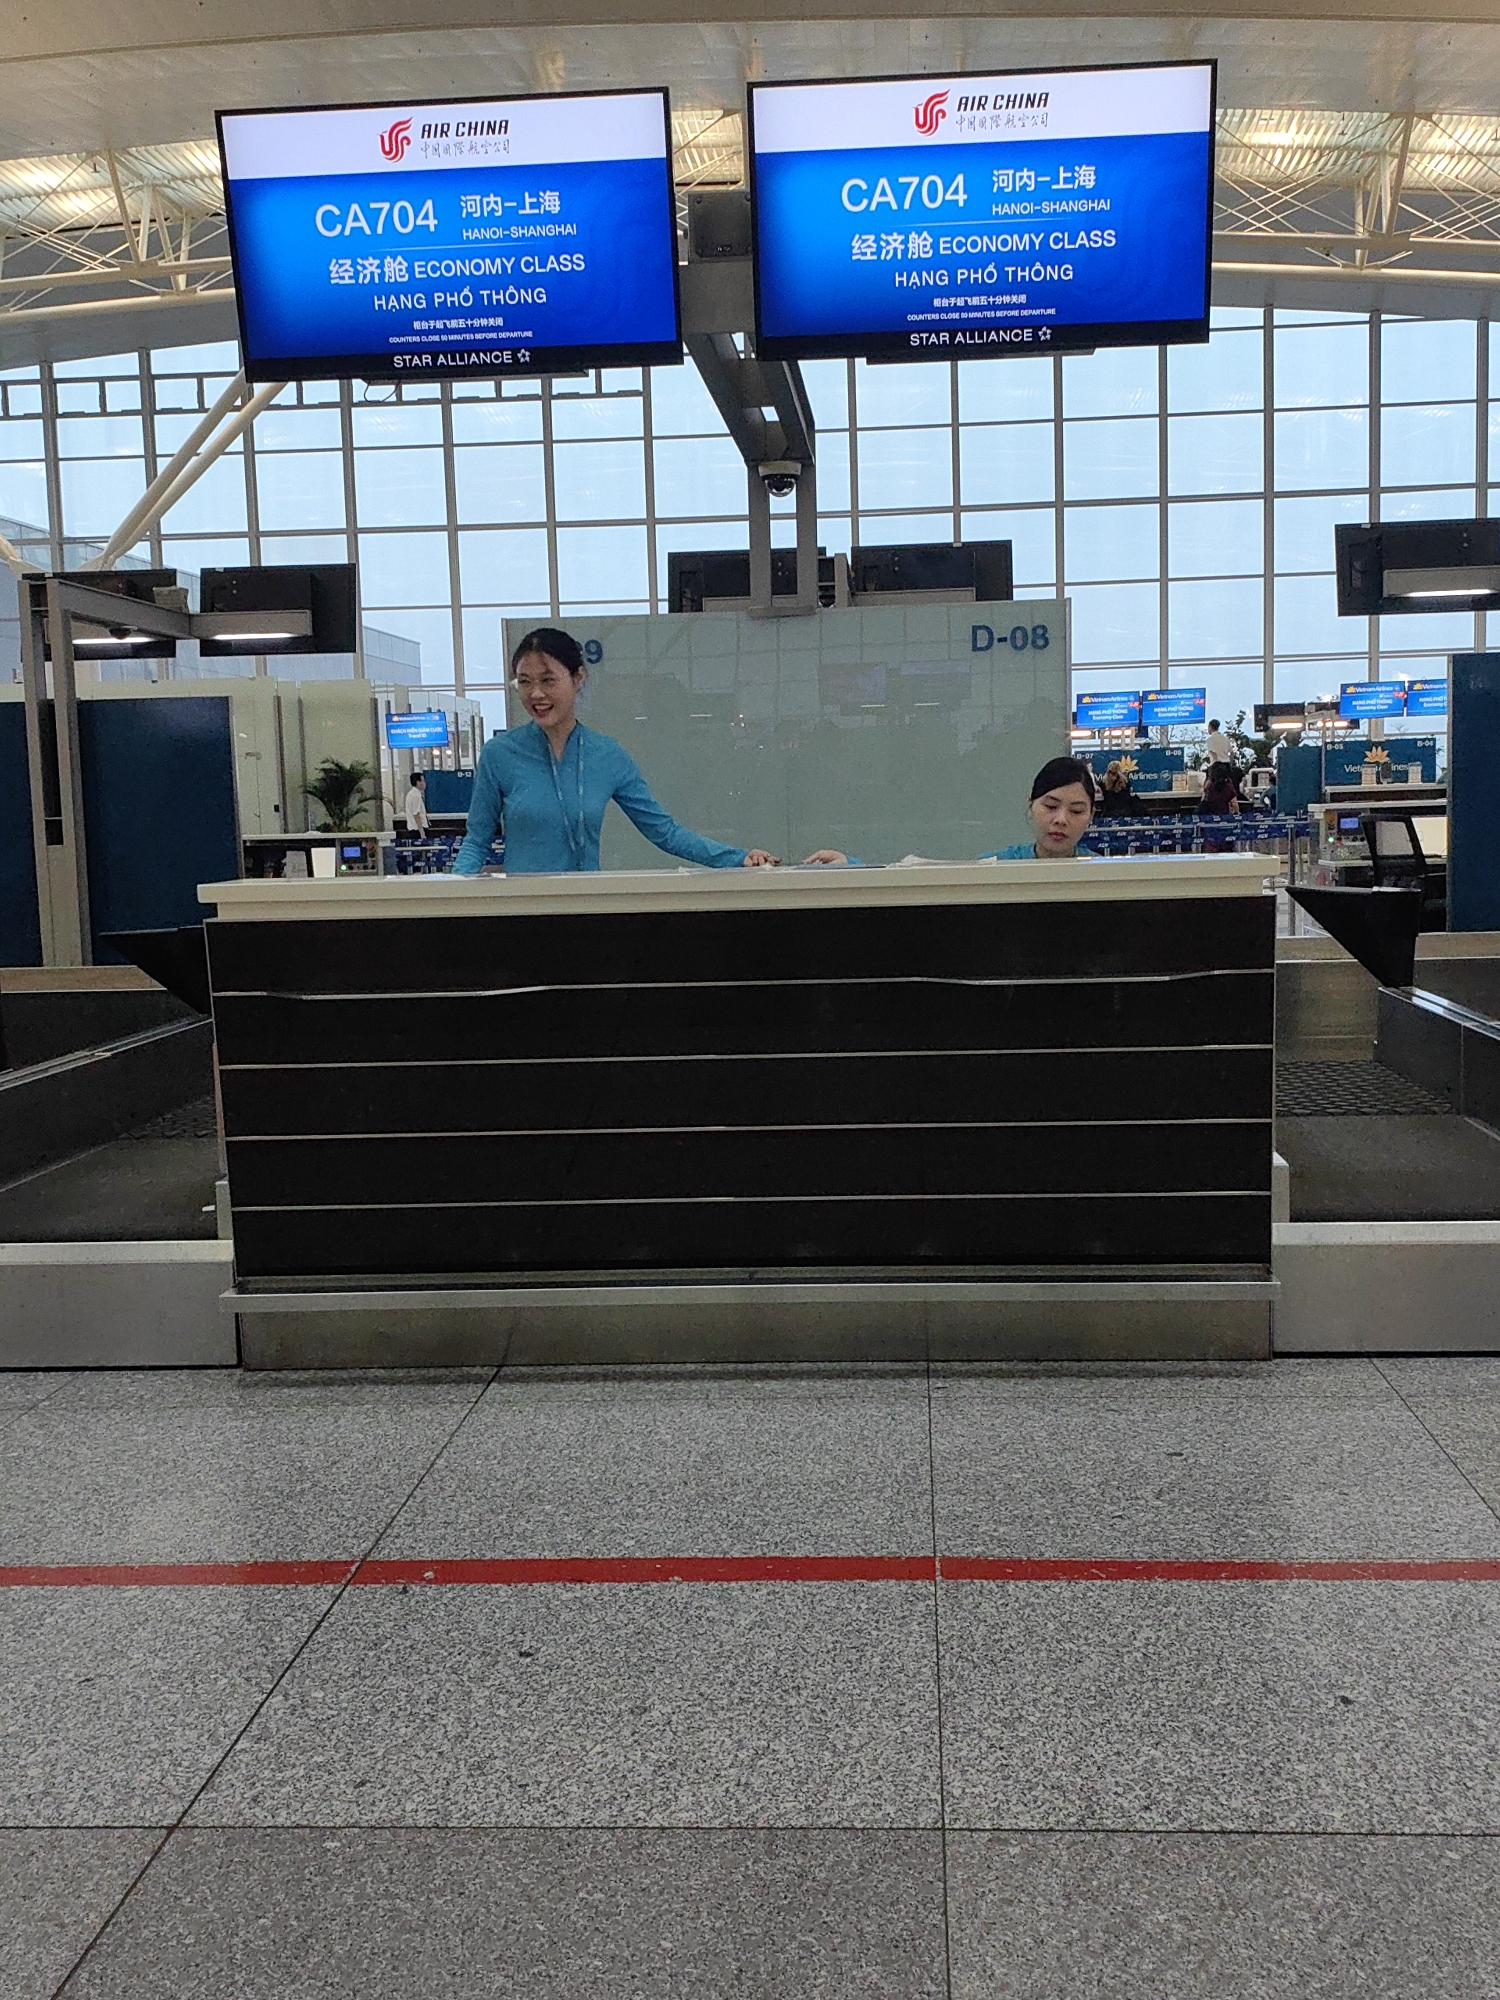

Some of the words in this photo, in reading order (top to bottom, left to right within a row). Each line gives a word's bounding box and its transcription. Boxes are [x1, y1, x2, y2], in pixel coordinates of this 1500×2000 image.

[956, 95, 988, 112] AIR
[992, 92, 1050, 110] CHINA
[421, 123, 450, 139] AIR
[455, 119, 510, 137] CHINA
[841, 173, 968, 213] CA704
[992, 199, 1111, 216] HANOI-SHANGHAI
[315, 199, 438, 237] CA704
[462, 223, 577, 241] HANOI-SHANGHAI
[851, 231, 934, 261] 经济舱
[939, 232, 1044, 255] ECONOMY
[1049, 229, 1117, 250] CLASS
[328, 255, 409, 285] 经济舱
[414, 256, 516, 279] ECONOMY
[520, 253, 586, 274] CLASS
[895, 270, 949, 289] HẠNG
[957, 262, 998, 285] PHỔ
[1004, 262, 1074, 283] THÔNG
[374, 293, 427, 313] HẠNG
[434, 286, 474, 308] PHỔ
[479, 285, 547, 306] THÔNG
[906, 313, 940, 321] COUNTERS
[940, 312, 960, 320] CLOSE
[969, 311, 995, 319] MINUTES
[995, 309, 1019, 317] BEFORE
[1020, 308, 1056, 316] DEPARTURE
[388, 335, 421, 343] COUNTERS
[448, 333, 475, 341] MINUTES
[498, 331, 533, 339] DEPARTURE
[910, 332, 950, 346] STAR
[954, 328, 1034, 344] ALLIANCE
[393, 354, 433, 368] STAR
[437, 350, 513, 367] ALLIANCE
[971, 624, 1049, 652] D-08
[1128, 771, 1158, 780] Airlines
